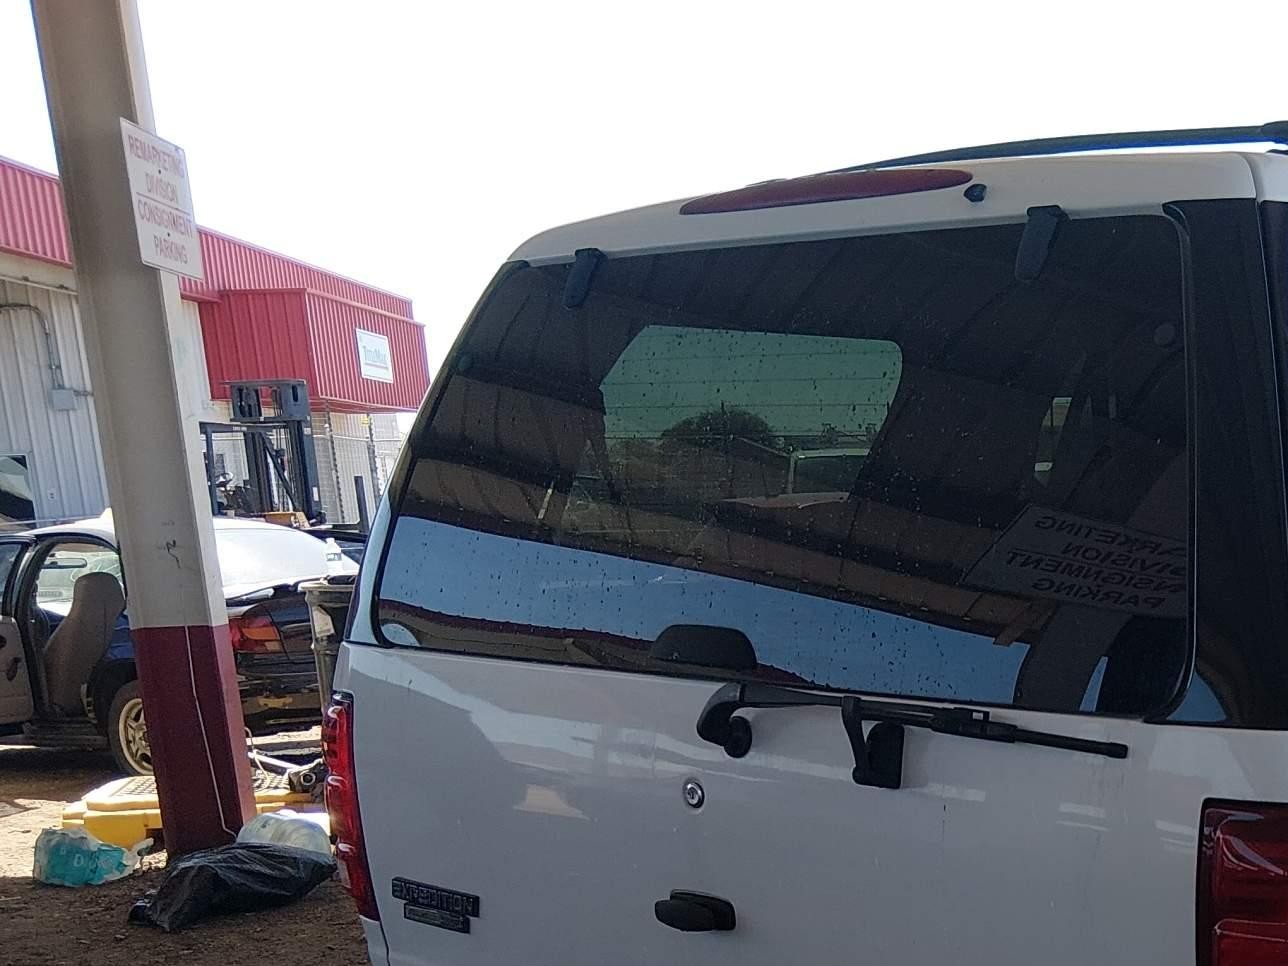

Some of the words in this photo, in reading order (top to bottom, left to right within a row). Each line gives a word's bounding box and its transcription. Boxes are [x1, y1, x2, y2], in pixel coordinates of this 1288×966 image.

[128, 134, 185, 178] REMARKETING
[145, 173, 178, 203] DIVISION
[137, 199, 193, 238] CONSIGNMENT
[153, 235, 188, 265] PARKING
